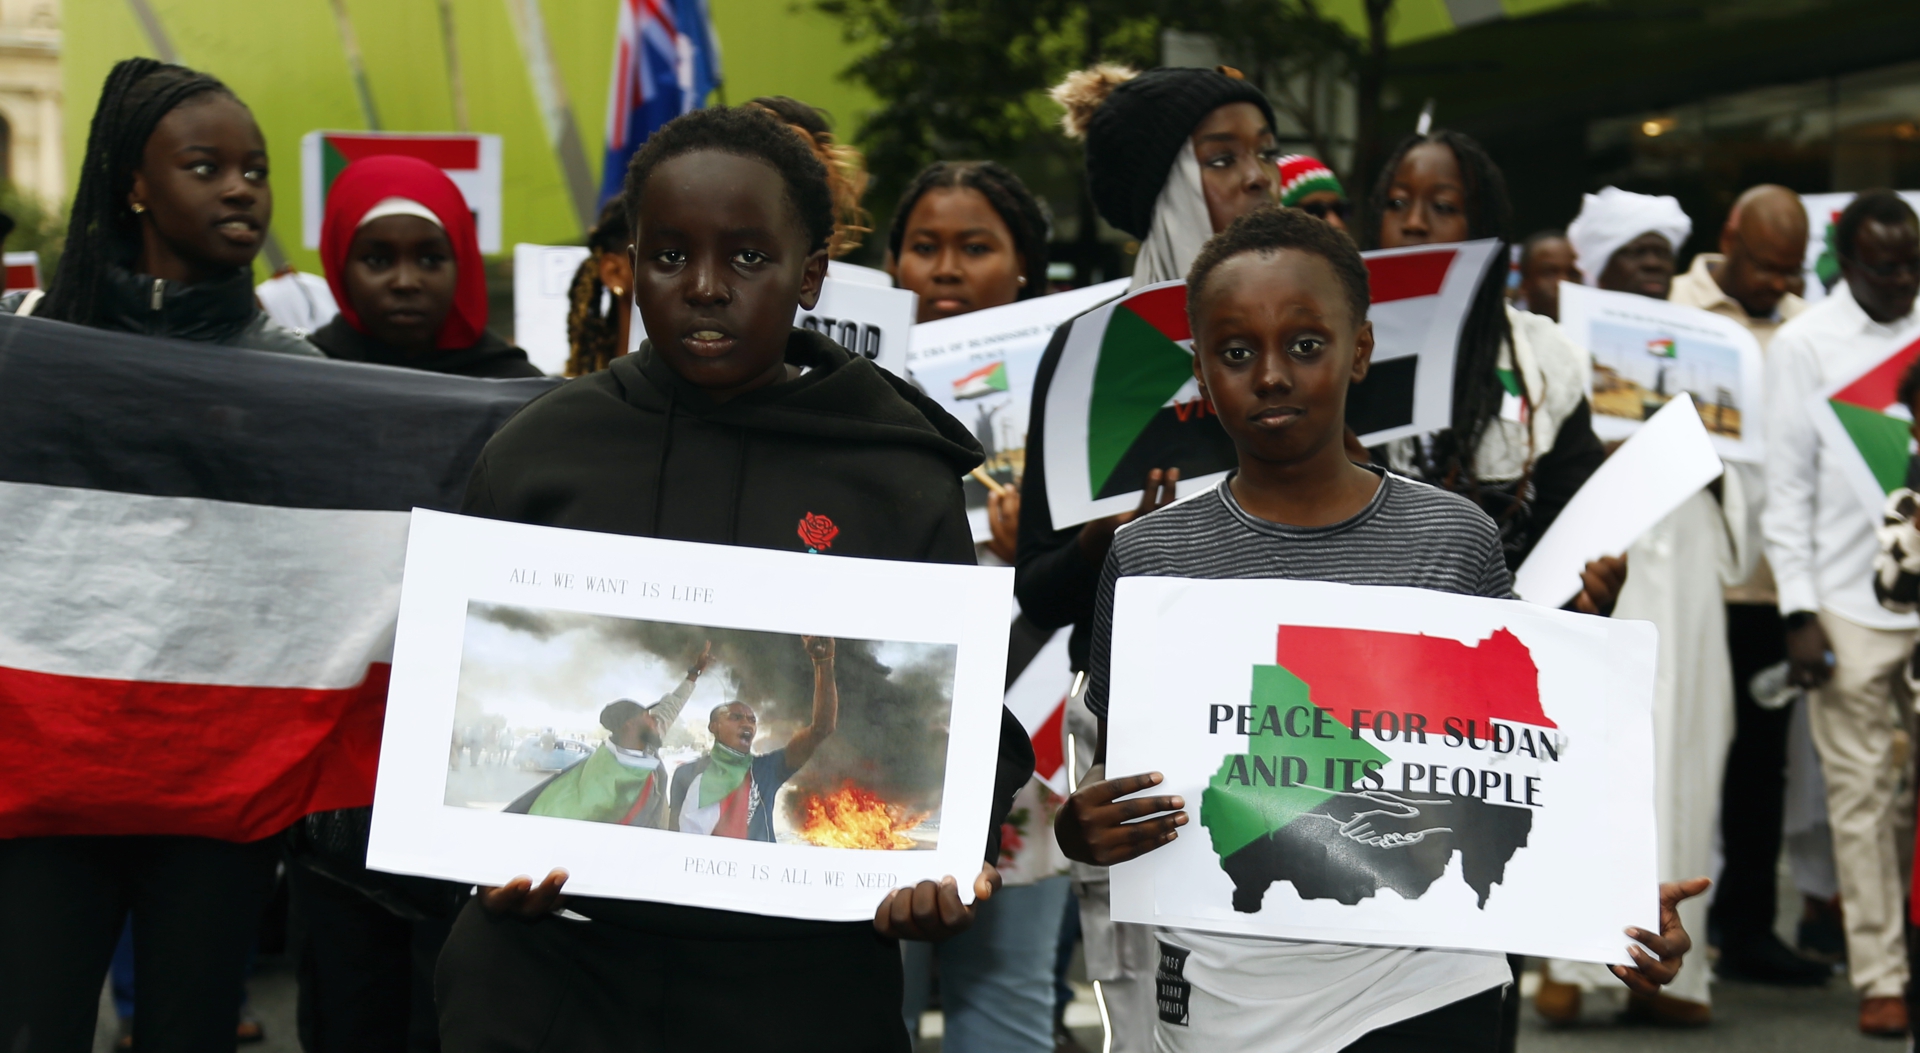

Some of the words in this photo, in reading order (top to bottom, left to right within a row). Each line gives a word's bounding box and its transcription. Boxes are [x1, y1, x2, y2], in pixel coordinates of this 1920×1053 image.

[509, 567, 542, 586] ALL
[553, 572, 575, 589] WE
[586, 575, 629, 595] WANT
[641, 581, 661, 598] IS
[671, 584, 715, 604] LIFE
[1208, 703, 1335, 739] PEACE
[1351, 708, 1427, 744] FOR
[1442, 716, 1558, 762] SUDAN
[1225, 754, 1308, 788] AND
[1324, 757, 1385, 791] ITS
[1402, 762, 1544, 808] PEOPLE
[684, 856, 738, 877] PEACE
[750, 863, 770, 881] IS
[780, 867, 813, 885] ALL
[824, 870, 845, 887] WE
[855, 872, 898, 889] NEED
